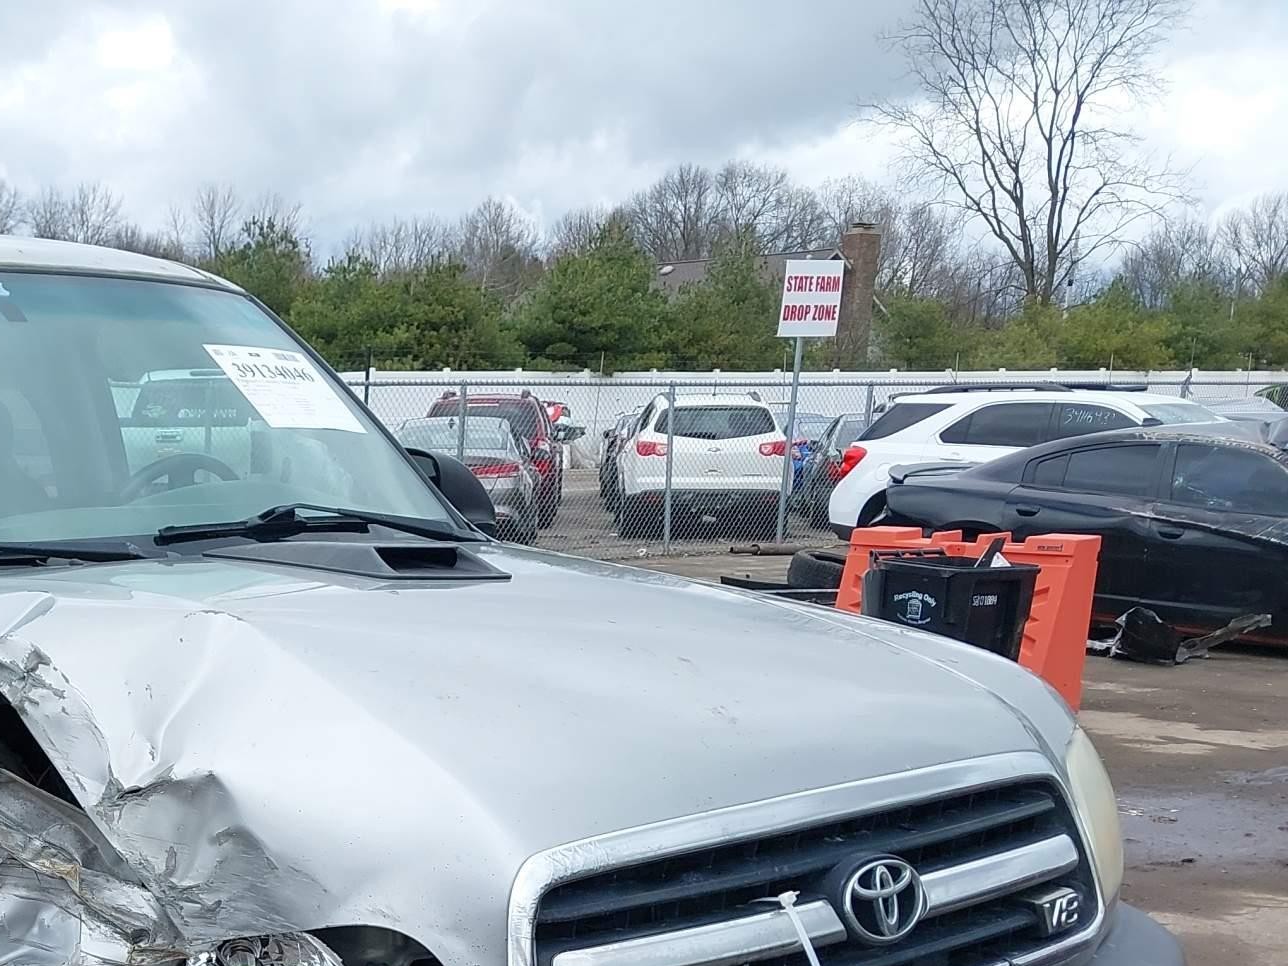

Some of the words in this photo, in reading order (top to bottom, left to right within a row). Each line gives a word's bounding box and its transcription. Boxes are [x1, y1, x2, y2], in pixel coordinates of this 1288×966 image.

[786, 275, 814, 293] STATE
[815, 275, 841, 293] FARM
[782, 304, 811, 321] DROP
[812, 304, 838, 321] ZONE
[231, 362, 315, 382] 39134046
[1042, 892, 1080, 936] V8
